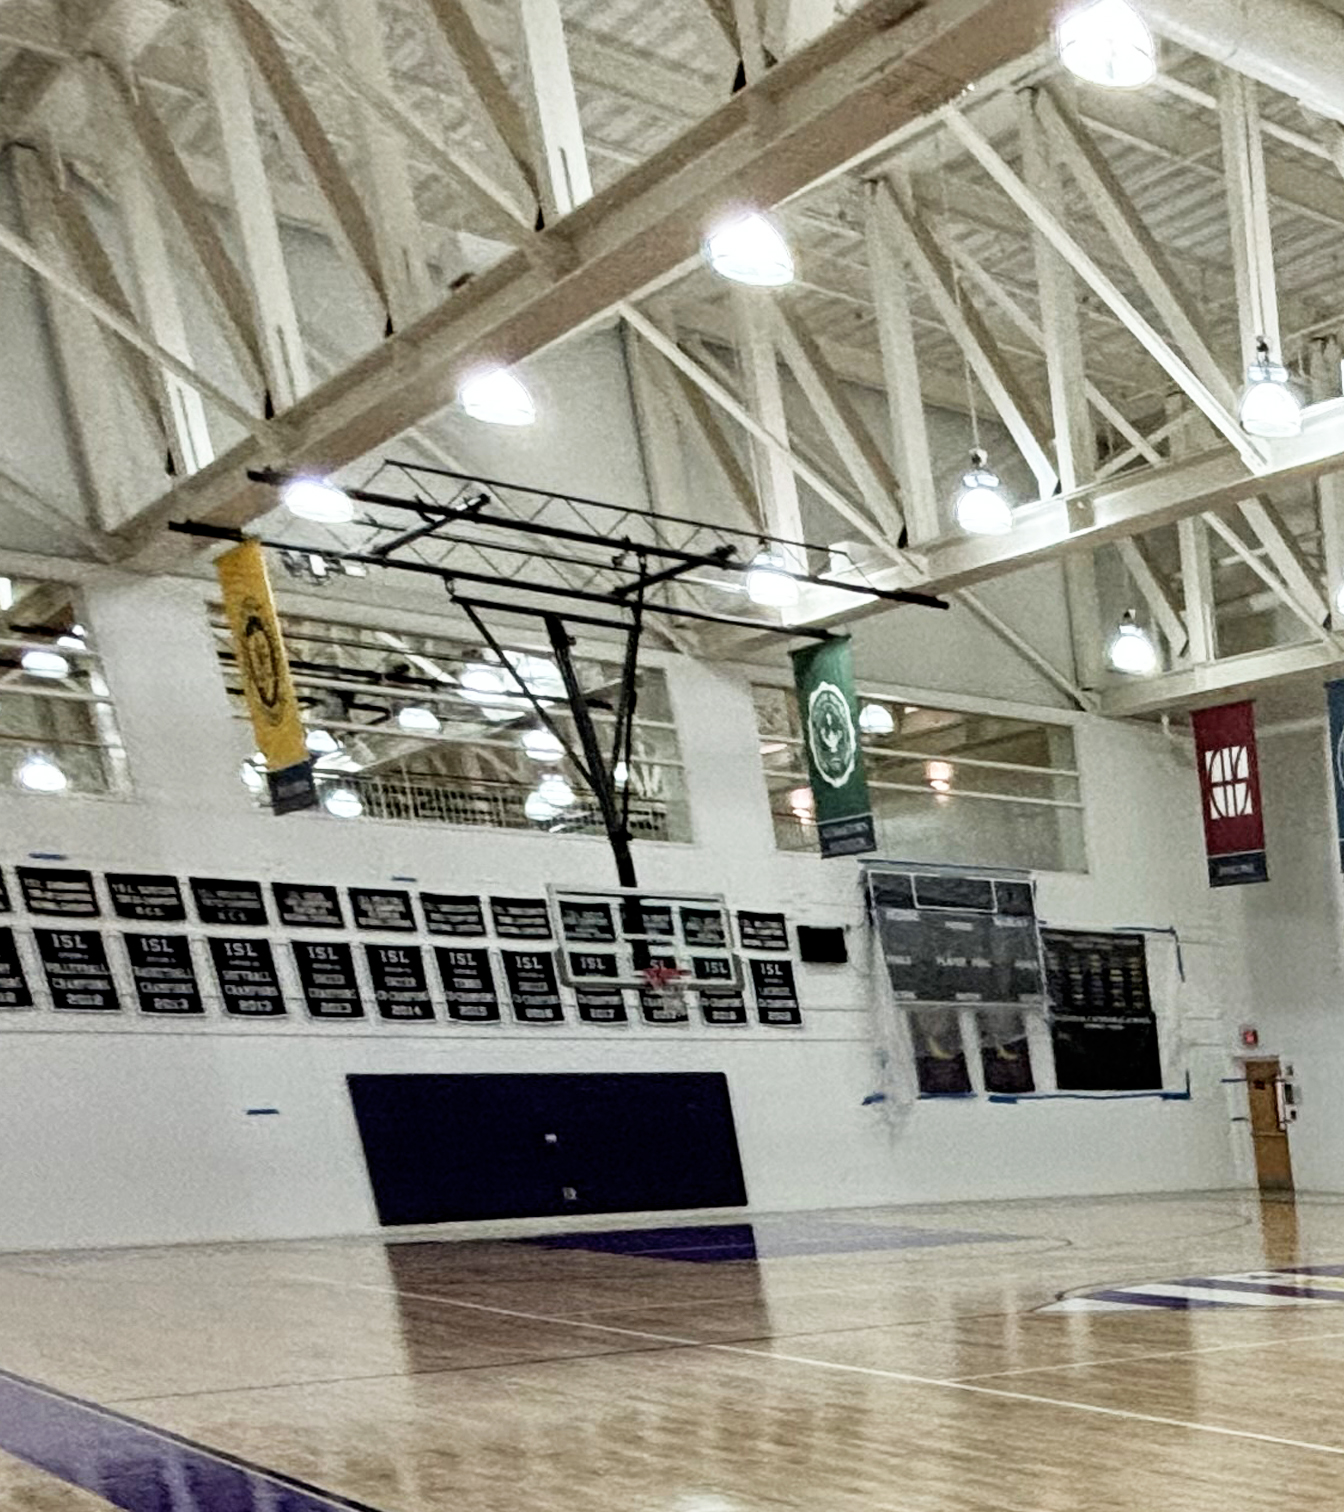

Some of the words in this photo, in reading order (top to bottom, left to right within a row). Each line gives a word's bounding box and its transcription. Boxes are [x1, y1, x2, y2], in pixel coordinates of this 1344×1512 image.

[51, 932, 88, 950] ISL
[140, 937, 175, 953] ISL
[224, 942, 259, 957] ISL
[306, 945, 340, 960] ISL
[378, 949, 410, 964] ISL
[449, 951, 478, 966] ISL
[514, 955, 543, 970] ISL
